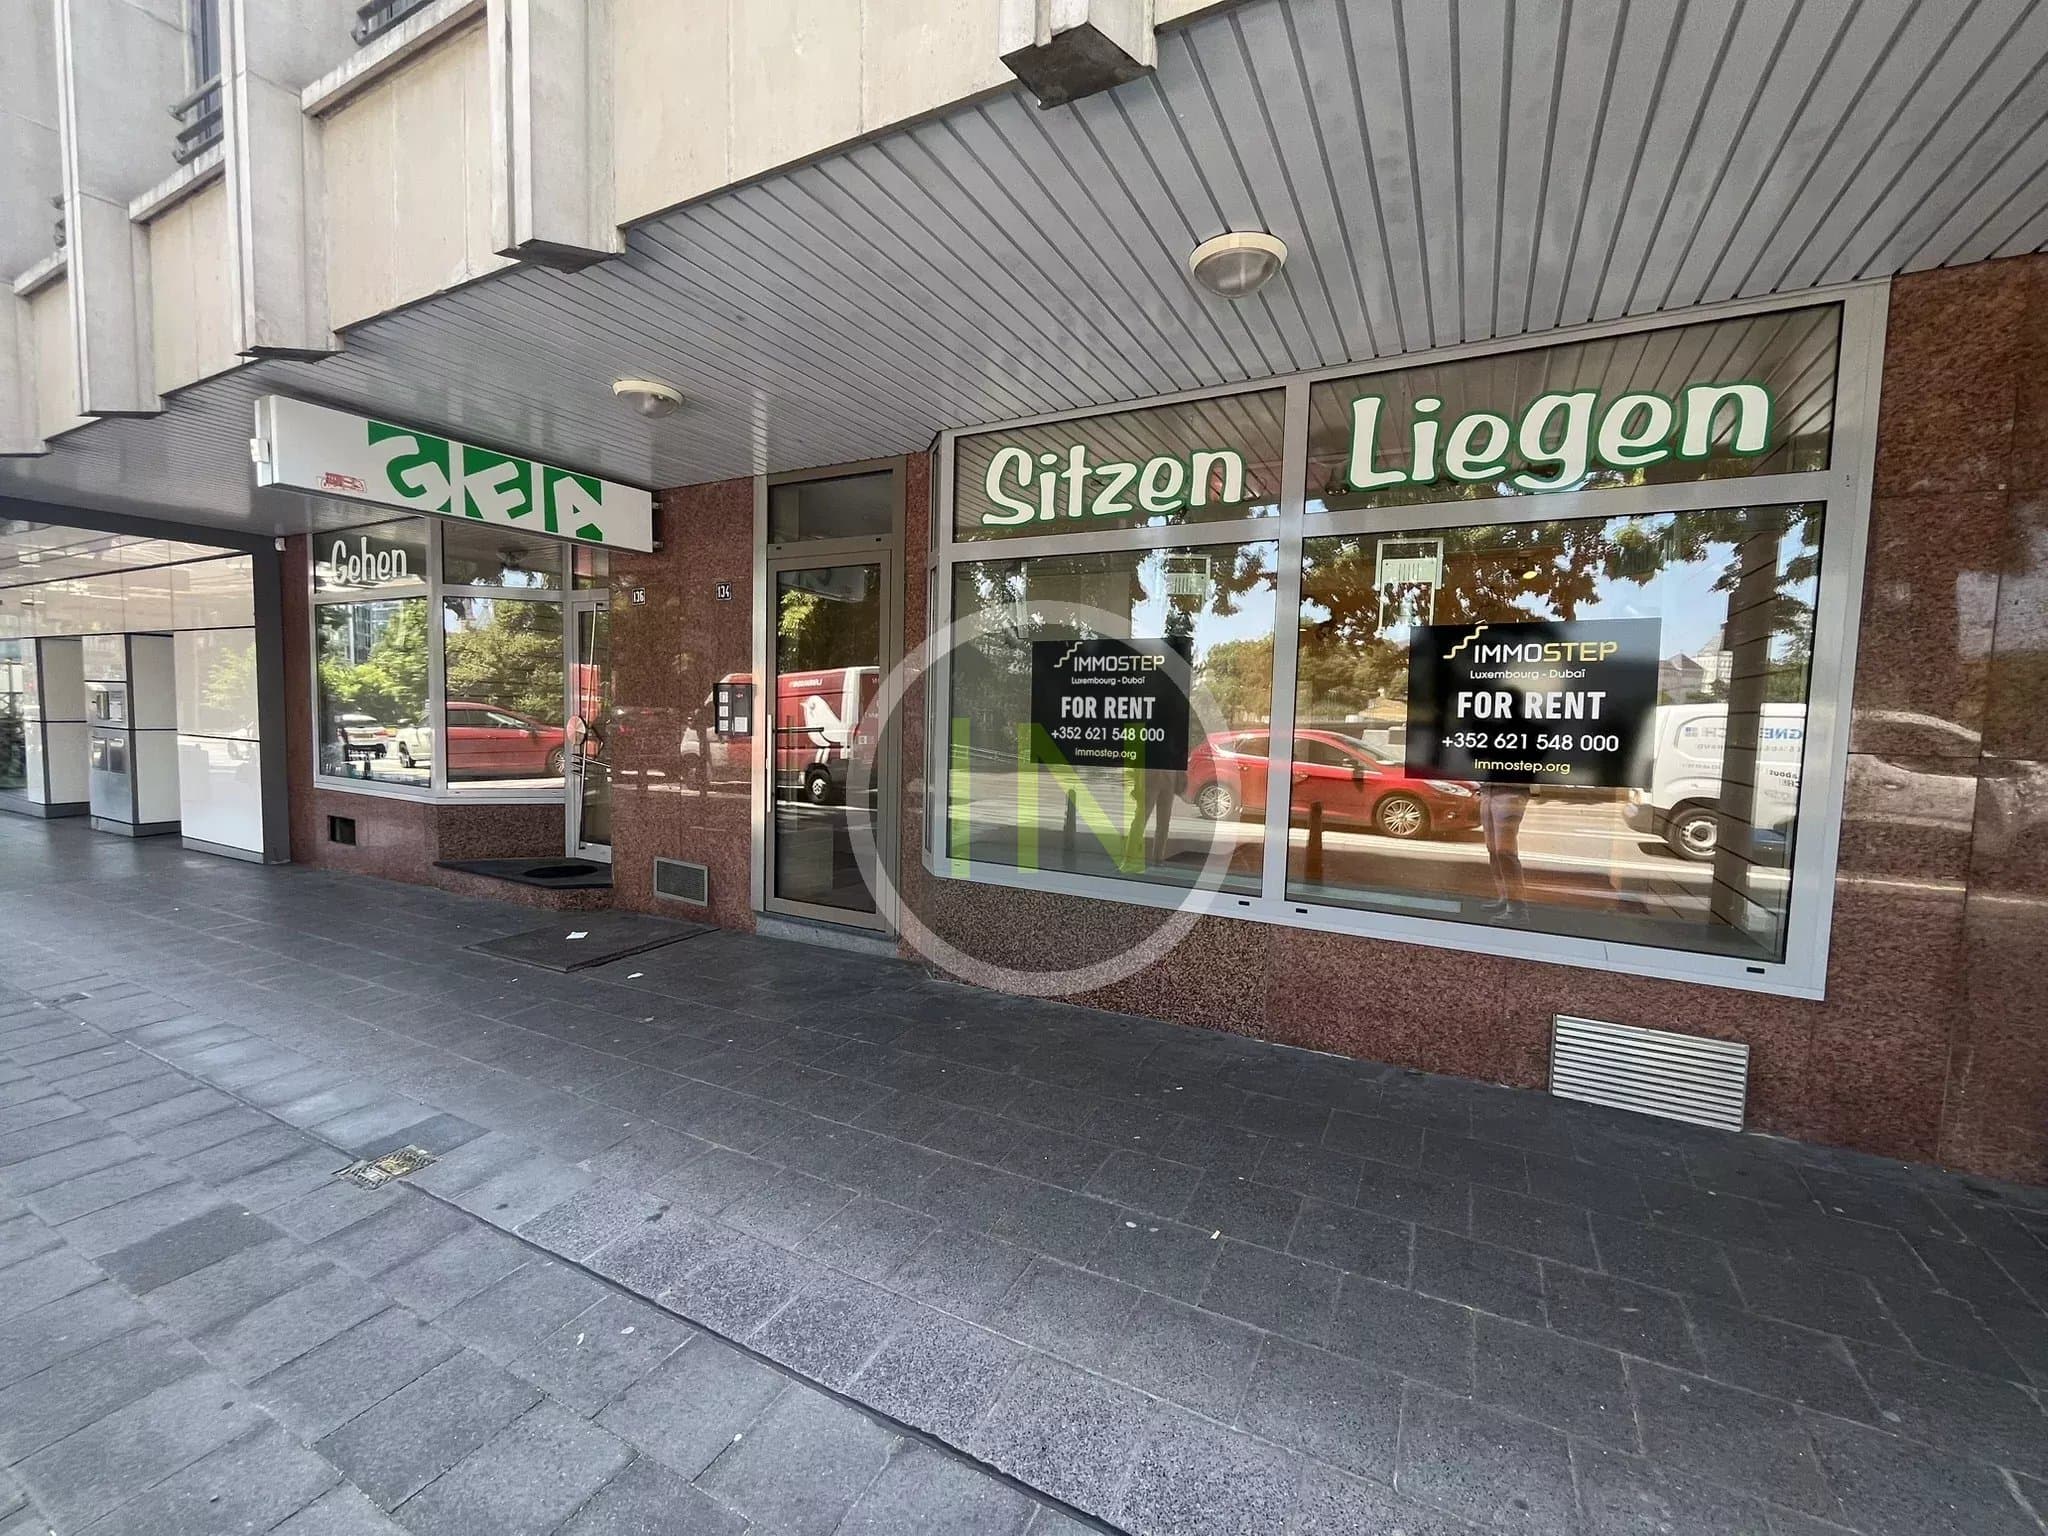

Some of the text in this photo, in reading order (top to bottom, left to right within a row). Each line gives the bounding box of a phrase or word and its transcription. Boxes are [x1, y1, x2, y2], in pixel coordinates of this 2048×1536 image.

[1348, 380, 1773, 491] Liegen
[368, 420, 603, 541] GEA
[981, 444, 1244, 526] Sitzen
[331, 536, 407, 583] Gehen
[632, 589, 645, 603] 136
[1074, 655, 1165, 672] IMMOSTEP
[1474, 641, 1618, 664] IMMOSTEP
[1071, 676, 1116, 686] Luxembourg
[1470, 669, 1540, 680] Luxembourg
[1061, 696, 1156, 719] FOR RENT
[1457, 691, 1607, 720] FOR RENT
[1051, 727, 1165, 742] +352 621 548 000
[1442, 733, 1619, 752] +352 621 548 000
